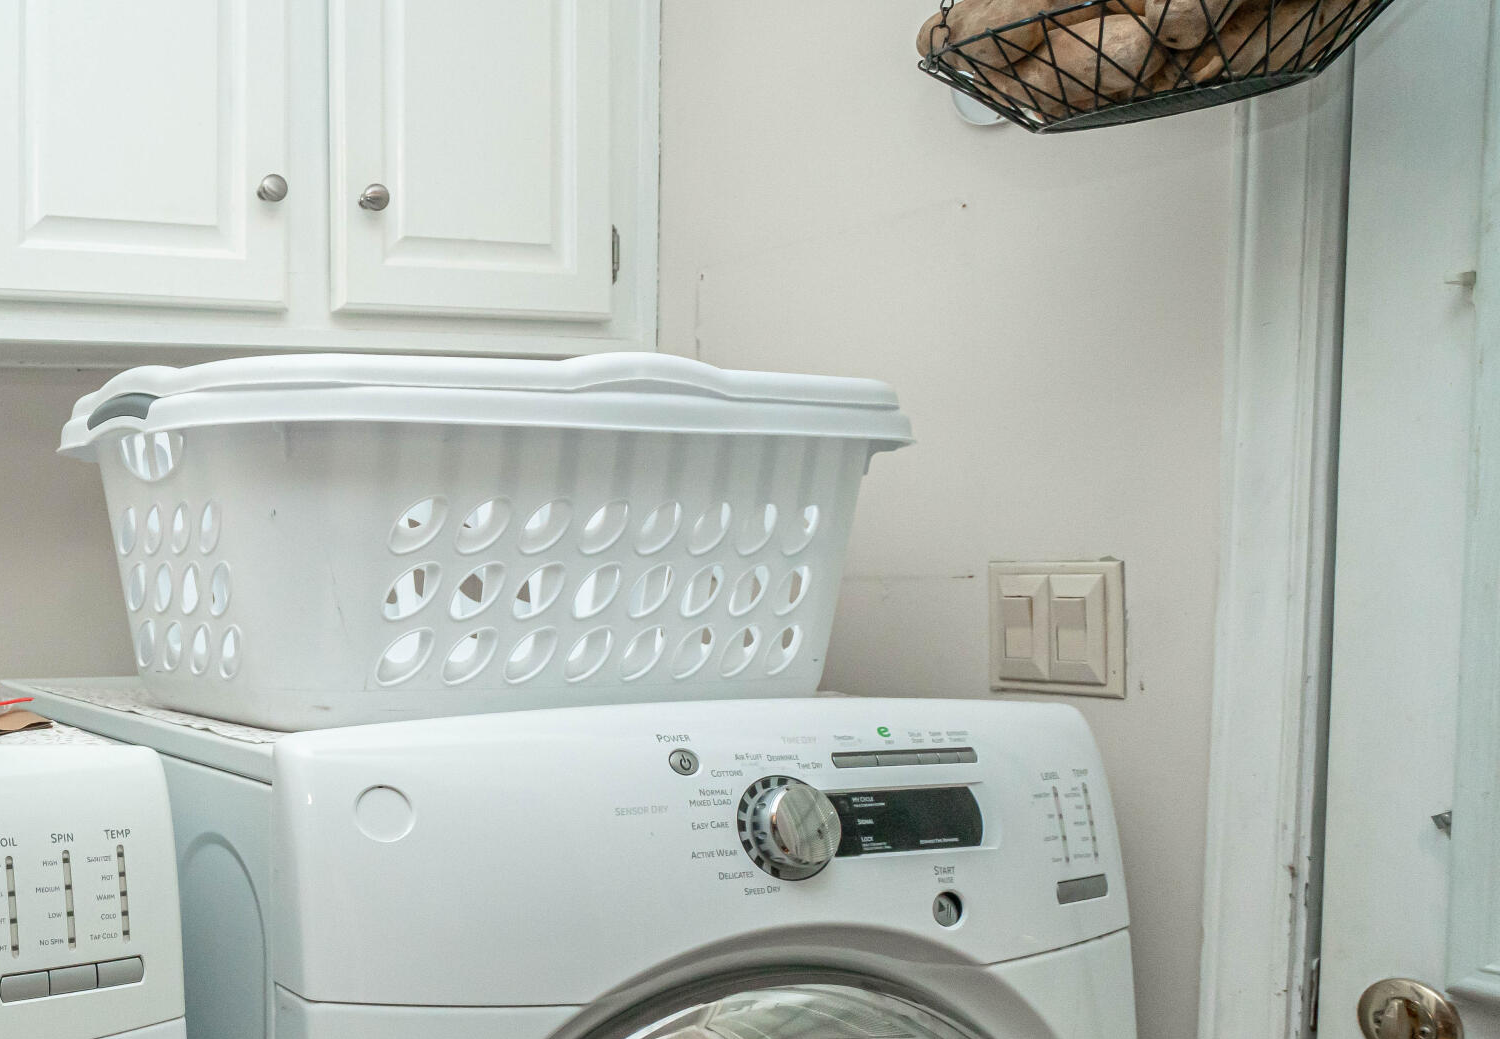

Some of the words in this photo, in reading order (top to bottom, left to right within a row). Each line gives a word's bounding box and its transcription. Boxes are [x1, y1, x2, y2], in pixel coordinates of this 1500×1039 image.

[656, 734, 691, 743] POWER
[710, 769, 744, 778] COTTONS
[699, 788, 728, 796] NORMAL
[689, 799, 711, 808] MIXED
[713, 798, 732, 807] LOAD
[614, 806, 649, 816] SENSOR
[651, 805, 669, 814] DRY
[691, 822, 709, 831] EASY
[710, 821, 730, 829] CARE
[50, 833, 74, 844] SPIN
[104, 828, 131, 840] TEMP
[691, 851, 715, 859] ACTIVE
[716, 849, 738, 858] WEAR
[718, 871, 755, 880] DELICATES
[933, 865, 956, 876] START
[35, 886, 60, 894] MEDIUM
[744, 887, 766, 896] SPEED
[767, 885, 780, 894] DRY
[102, 932, 118, 940] COLD
[40, 939, 50, 947] NO
